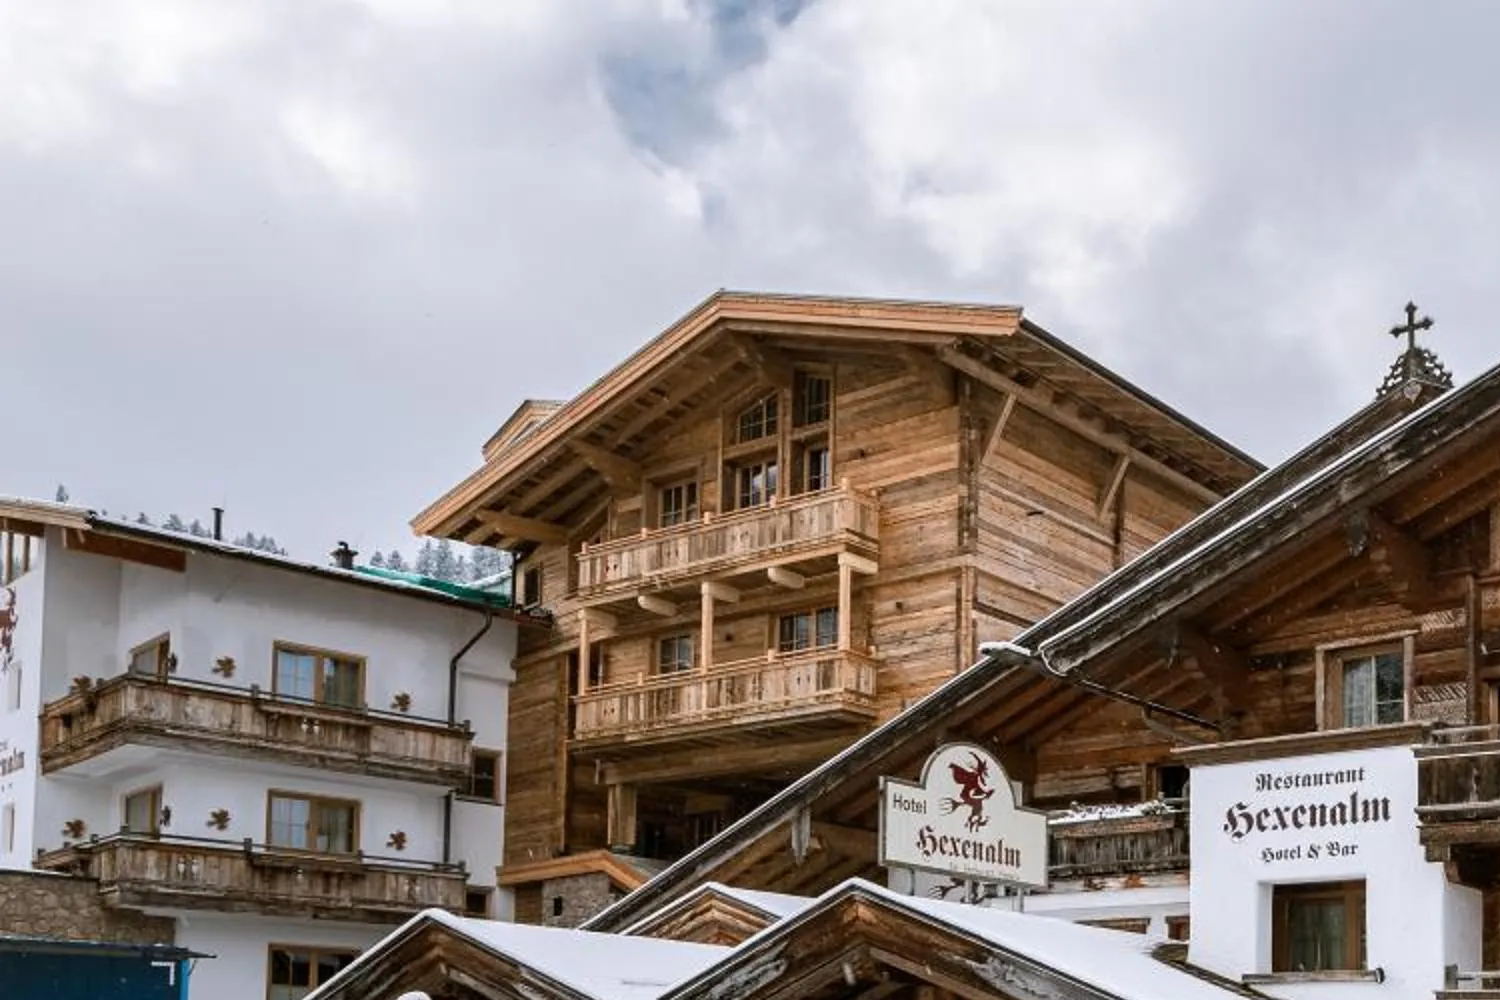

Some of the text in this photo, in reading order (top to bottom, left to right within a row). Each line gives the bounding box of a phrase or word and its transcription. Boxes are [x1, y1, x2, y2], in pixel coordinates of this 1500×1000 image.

[1255, 766, 1365, 792] Restaurant
[892, 792, 927, 815] Hotel
[1223, 791, 1391, 843] Hexenalm
[916, 825, 1021, 868] Hexenalm
[1262, 841, 1359, 863] Hotel & Bar
